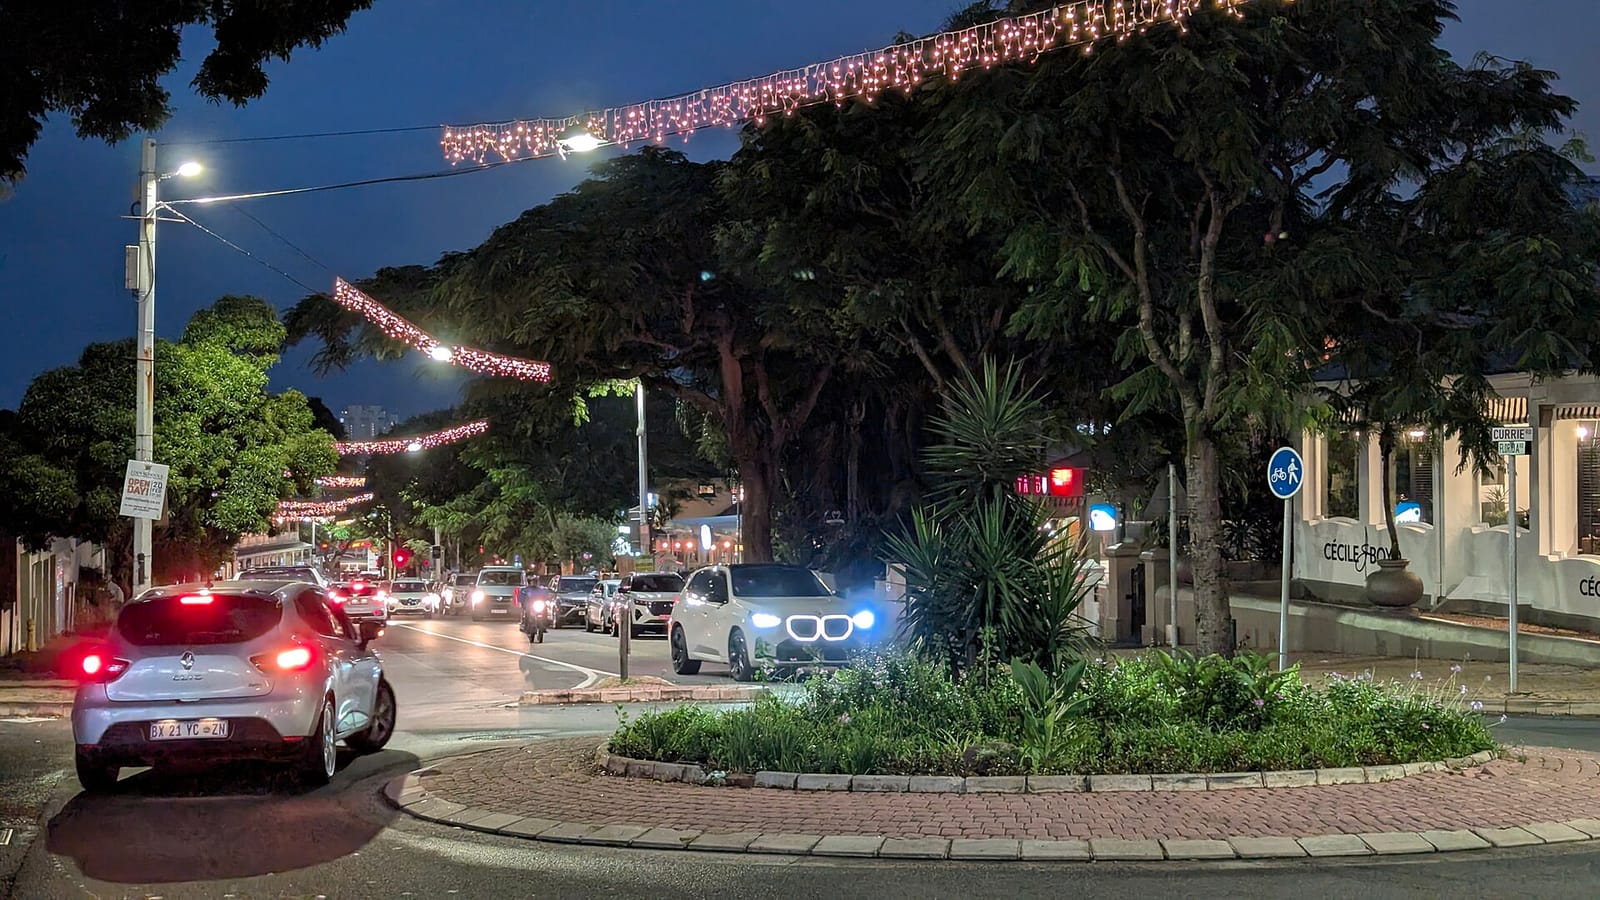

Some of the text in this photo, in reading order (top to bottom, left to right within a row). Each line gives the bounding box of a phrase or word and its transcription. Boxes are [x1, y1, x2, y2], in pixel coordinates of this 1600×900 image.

[1494, 429, 1524, 439] CURRIE
[128, 478, 162, 489] OPEN 20
[128, 485, 149, 496] DAY!
[1324, 539, 1359, 562] CÉCILE
[1370, 546, 1401, 564] BOY
[151, 723, 225, 738] BX 21 YC ZN
